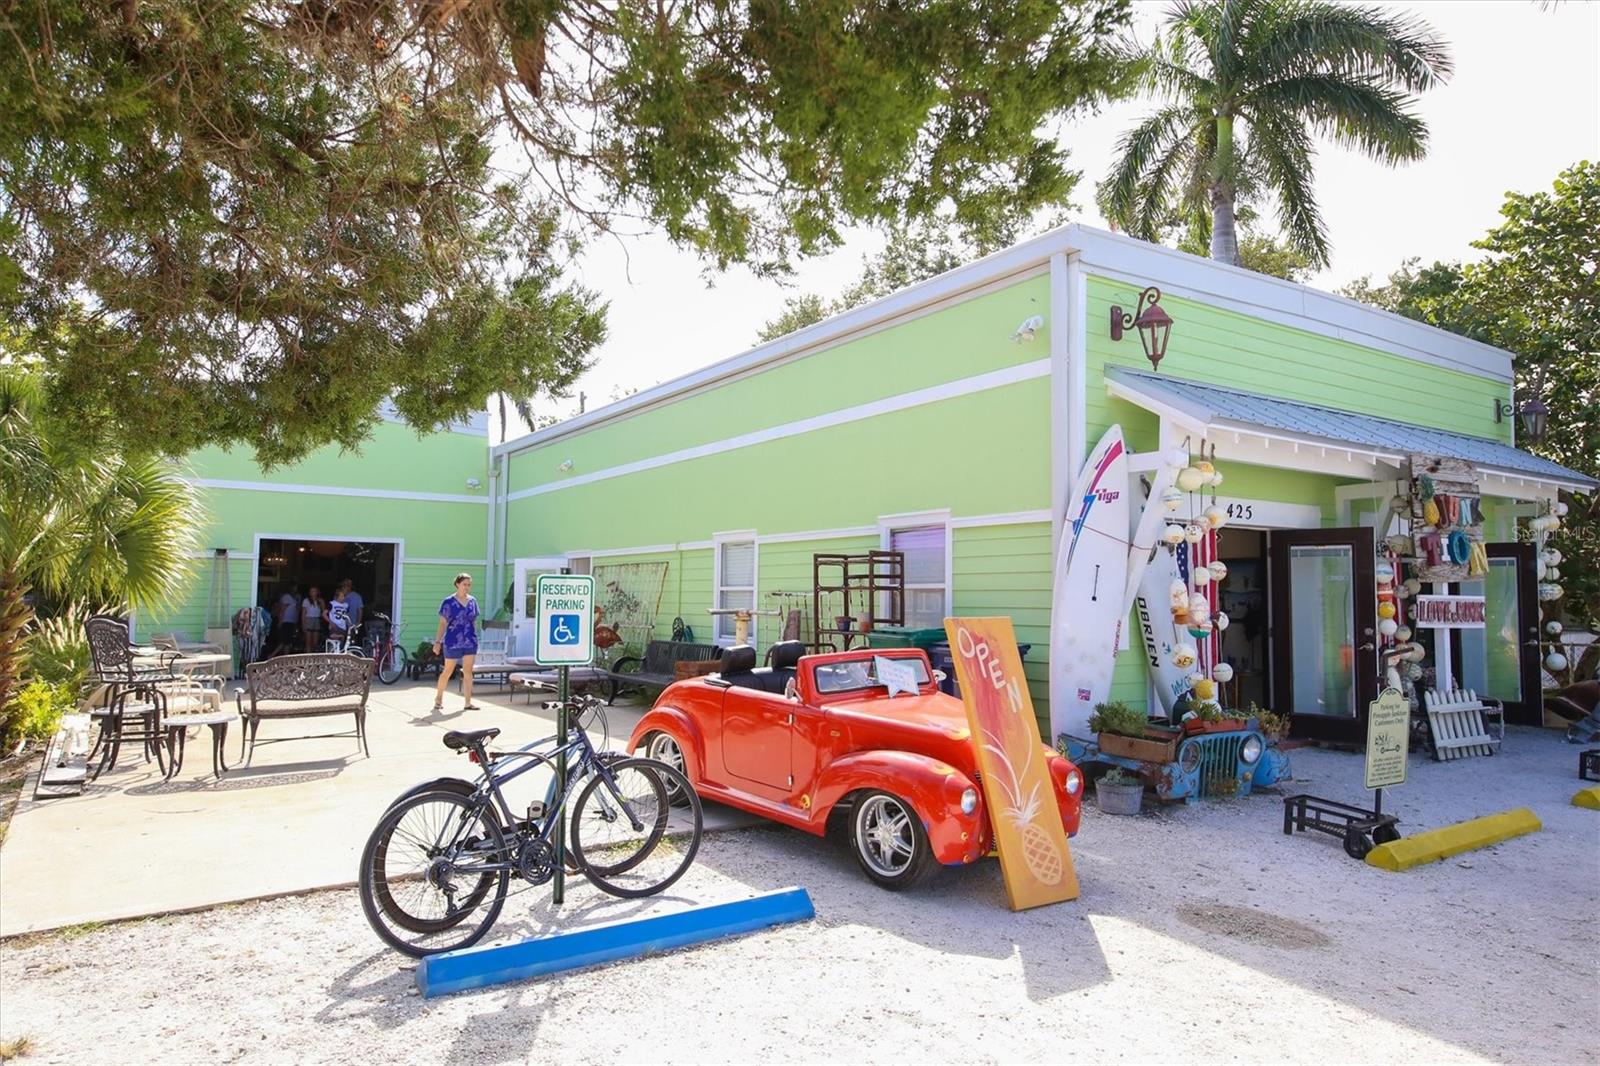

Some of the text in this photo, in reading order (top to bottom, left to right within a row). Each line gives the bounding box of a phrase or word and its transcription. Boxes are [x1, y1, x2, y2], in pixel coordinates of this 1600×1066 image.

[1226, 503, 1253, 520] 425
[1420, 530, 1490, 577] TION
[541, 583, 590, 596] RESERVED
[545, 599, 585, 611] PARKING
[1137, 596, 1160, 668] OBRIEN
